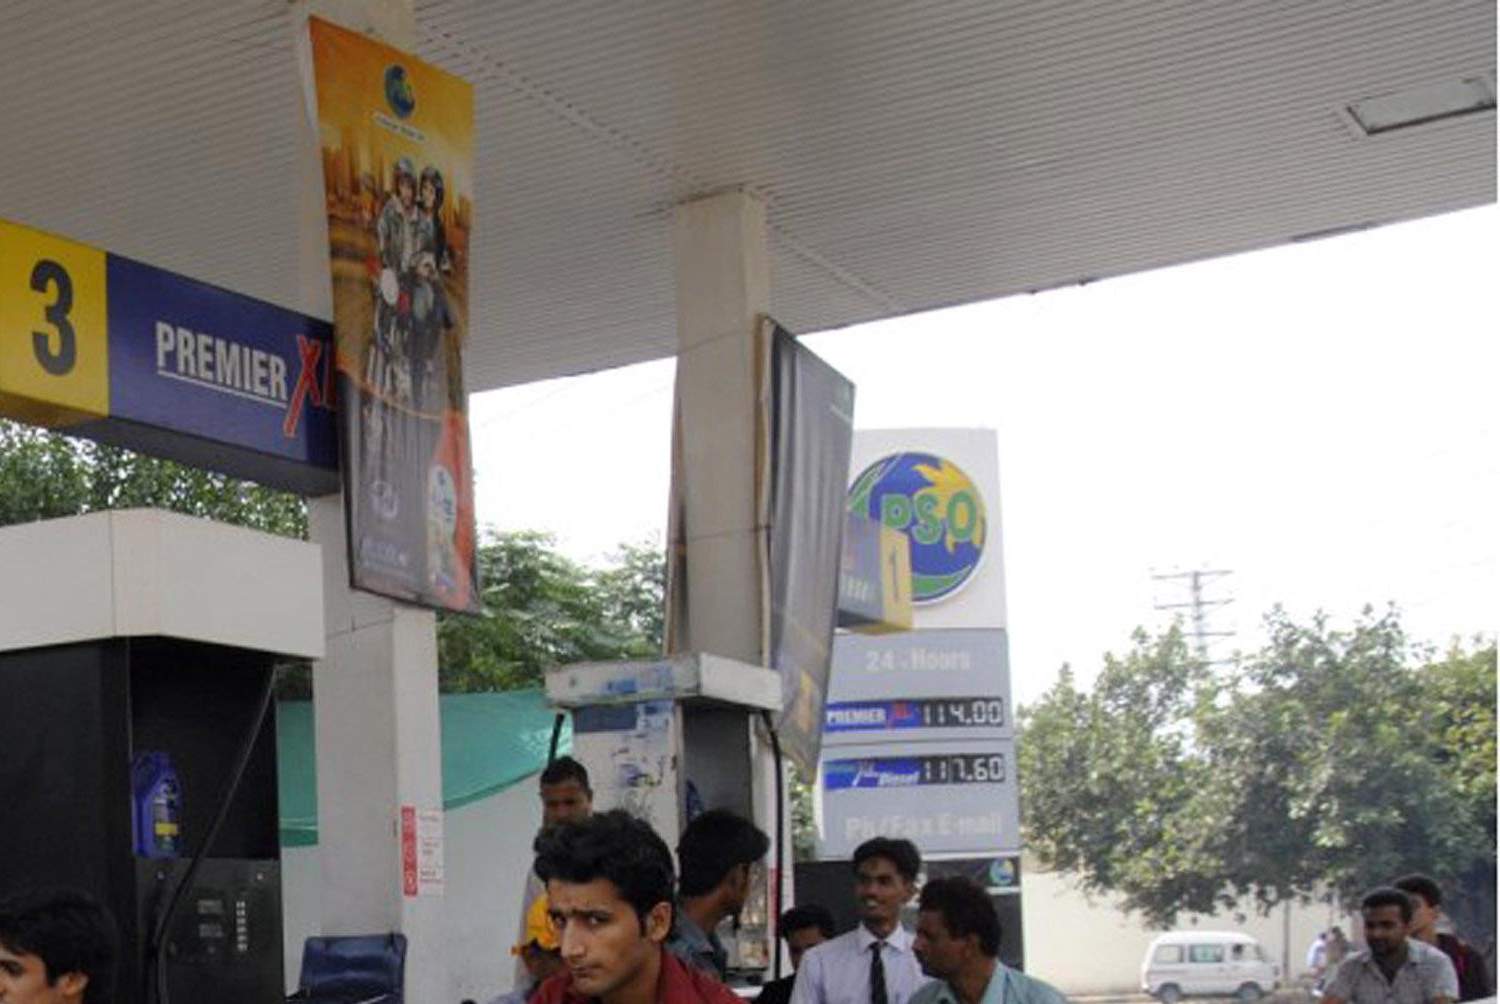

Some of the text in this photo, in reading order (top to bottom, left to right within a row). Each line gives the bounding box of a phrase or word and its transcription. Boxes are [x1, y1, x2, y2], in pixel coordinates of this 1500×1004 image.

[29, 259, 77, 376] 3
[155, 320, 288, 400] PREMIER
[880, 490, 978, 545] PSO
[866, 650, 895, 672] 24
[826, 707, 887, 726] PREMIER
[923, 700, 1003, 725] 114.00
[924, 757, 1003, 782] 117.60
